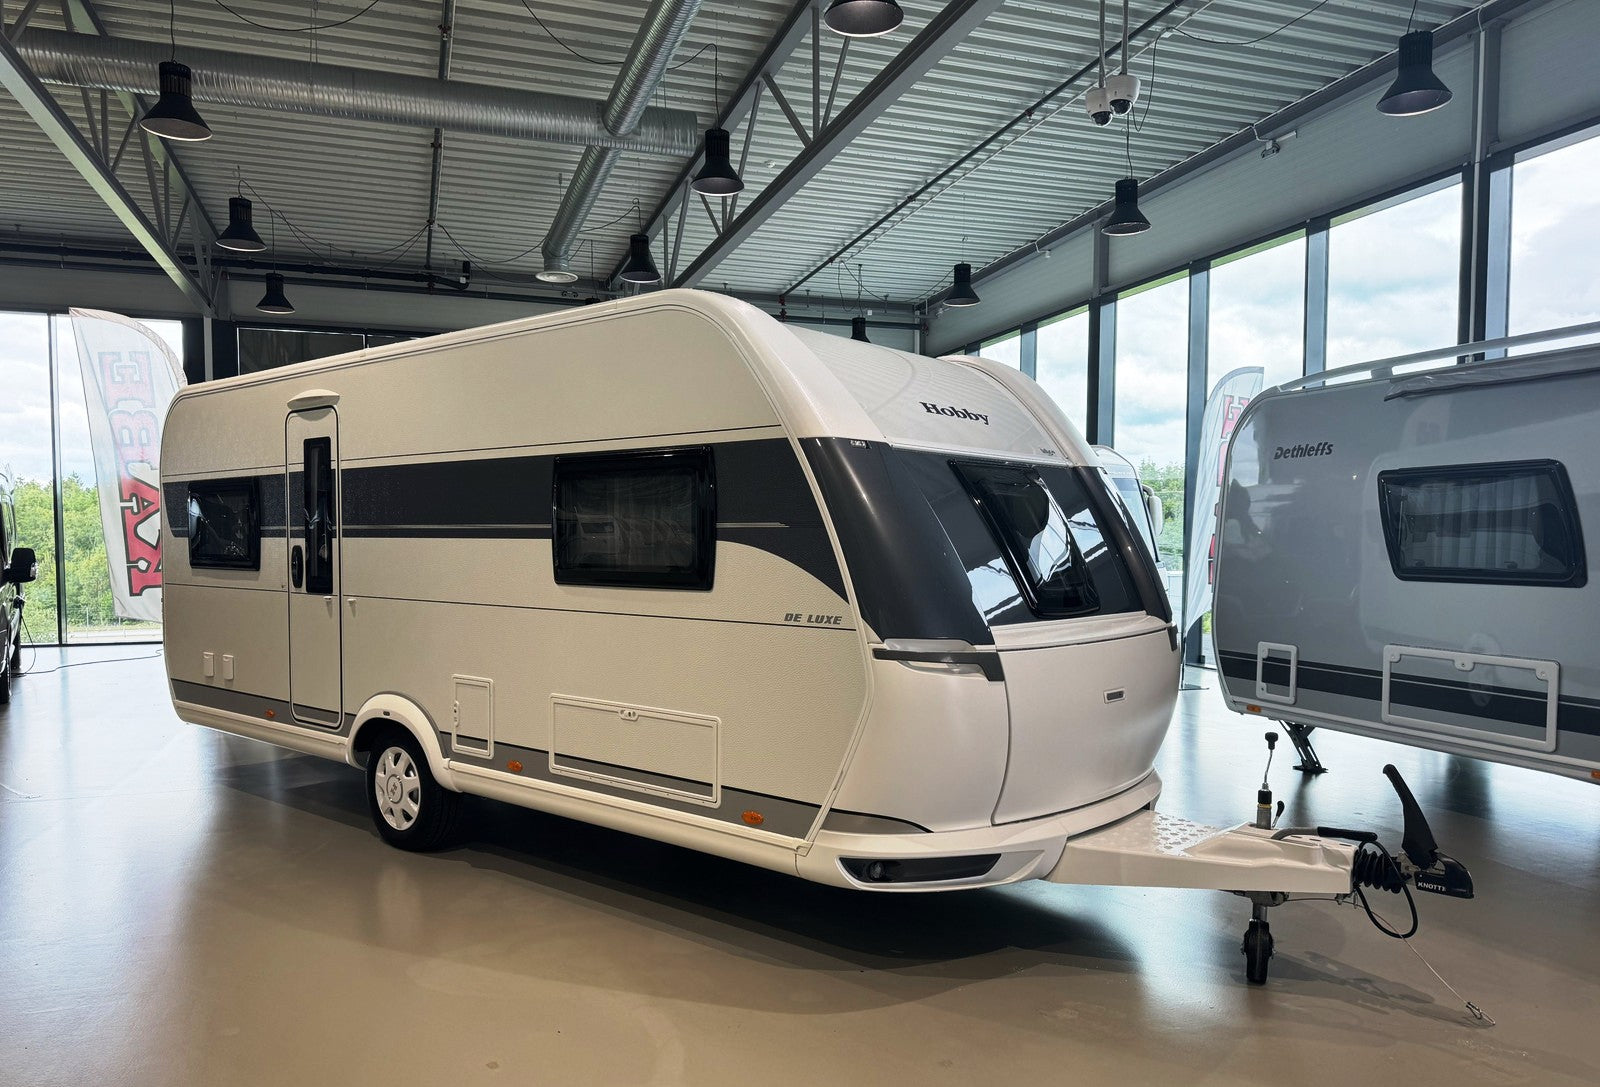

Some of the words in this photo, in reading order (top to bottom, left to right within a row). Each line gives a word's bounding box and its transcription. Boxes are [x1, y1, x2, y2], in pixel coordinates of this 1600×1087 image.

[919, 401, 989, 425] Hobby
[1273, 441, 1334, 460] Dethleffs
[783, 612, 803, 623] DE
[806, 614, 843, 625] LUXE
